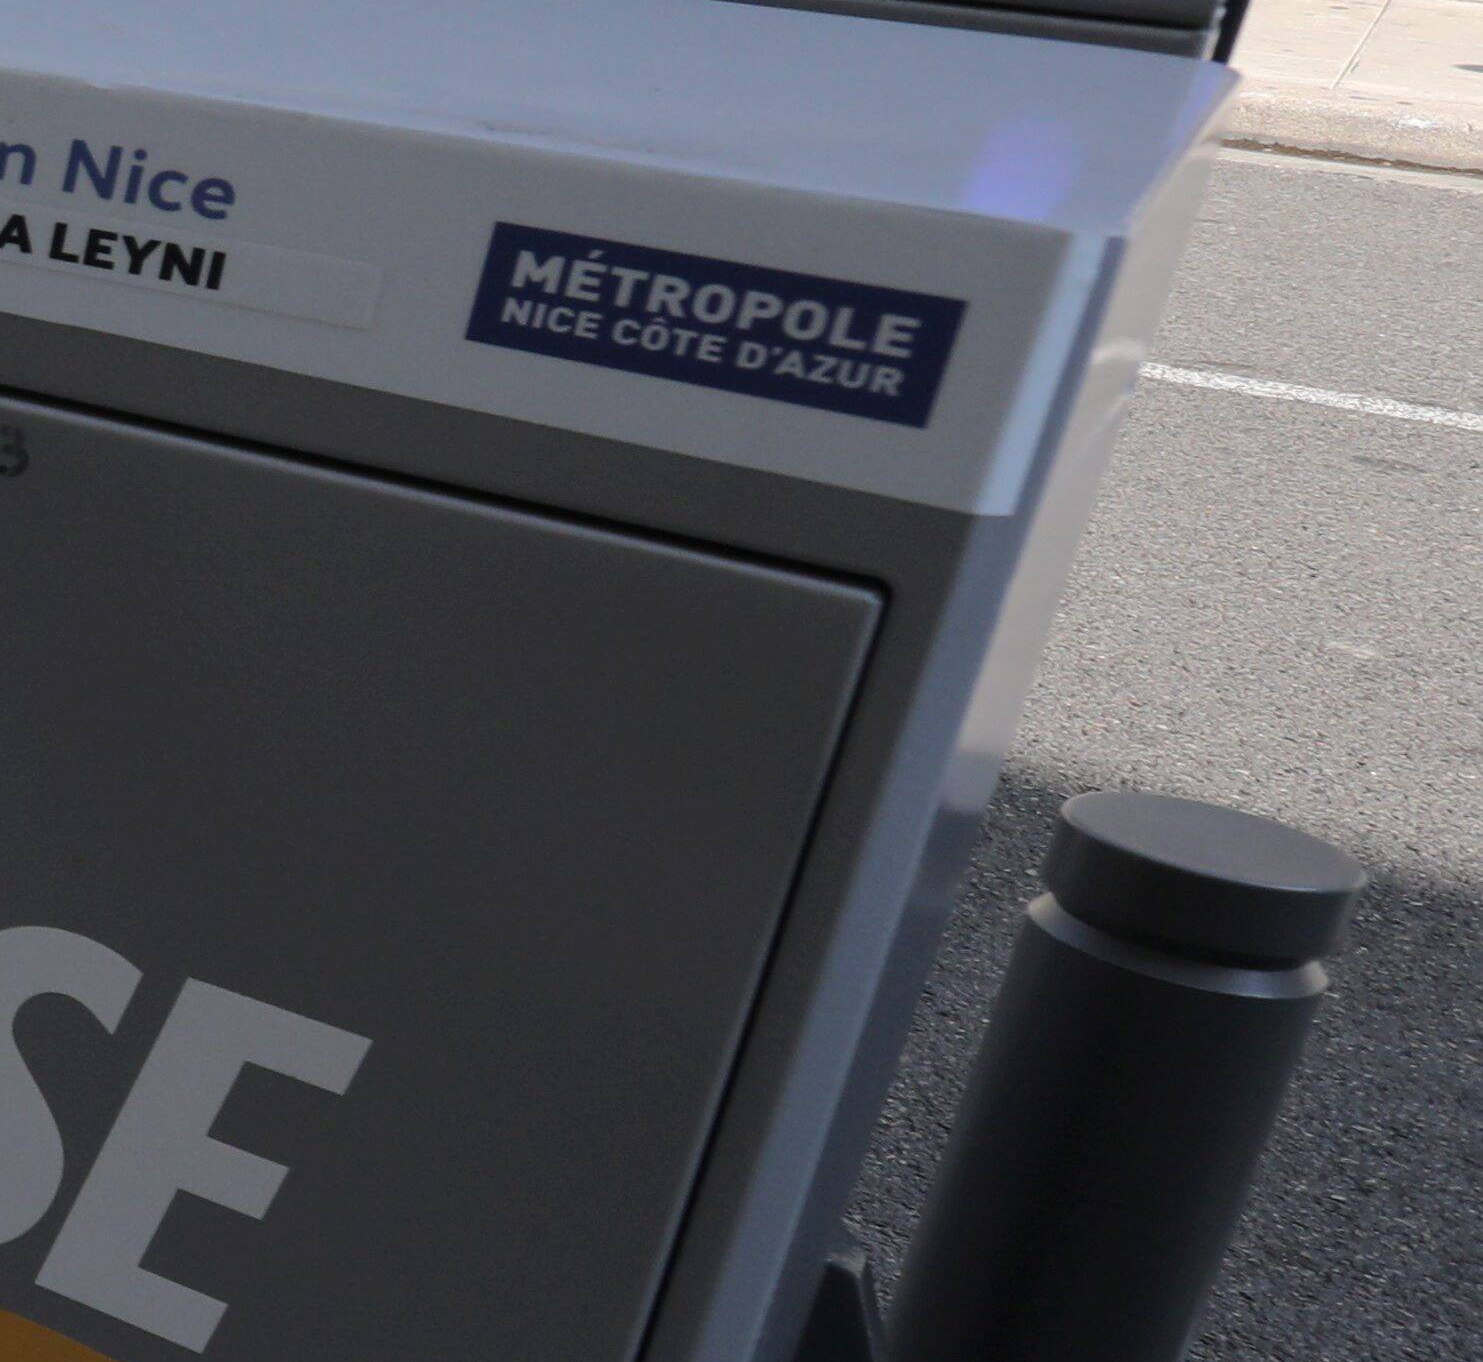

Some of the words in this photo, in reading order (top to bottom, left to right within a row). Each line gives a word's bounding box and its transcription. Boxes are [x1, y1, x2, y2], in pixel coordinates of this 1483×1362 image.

[62, 139, 236, 221] Nice
[49, 222, 227, 291] LEYNI
[501, 298, 603, 339] NICE
[611, 317, 728, 365] CÔTE
[736, 343, 906, 397] D'AZUR
[511, 249, 923, 359] MÉTROPOLE
